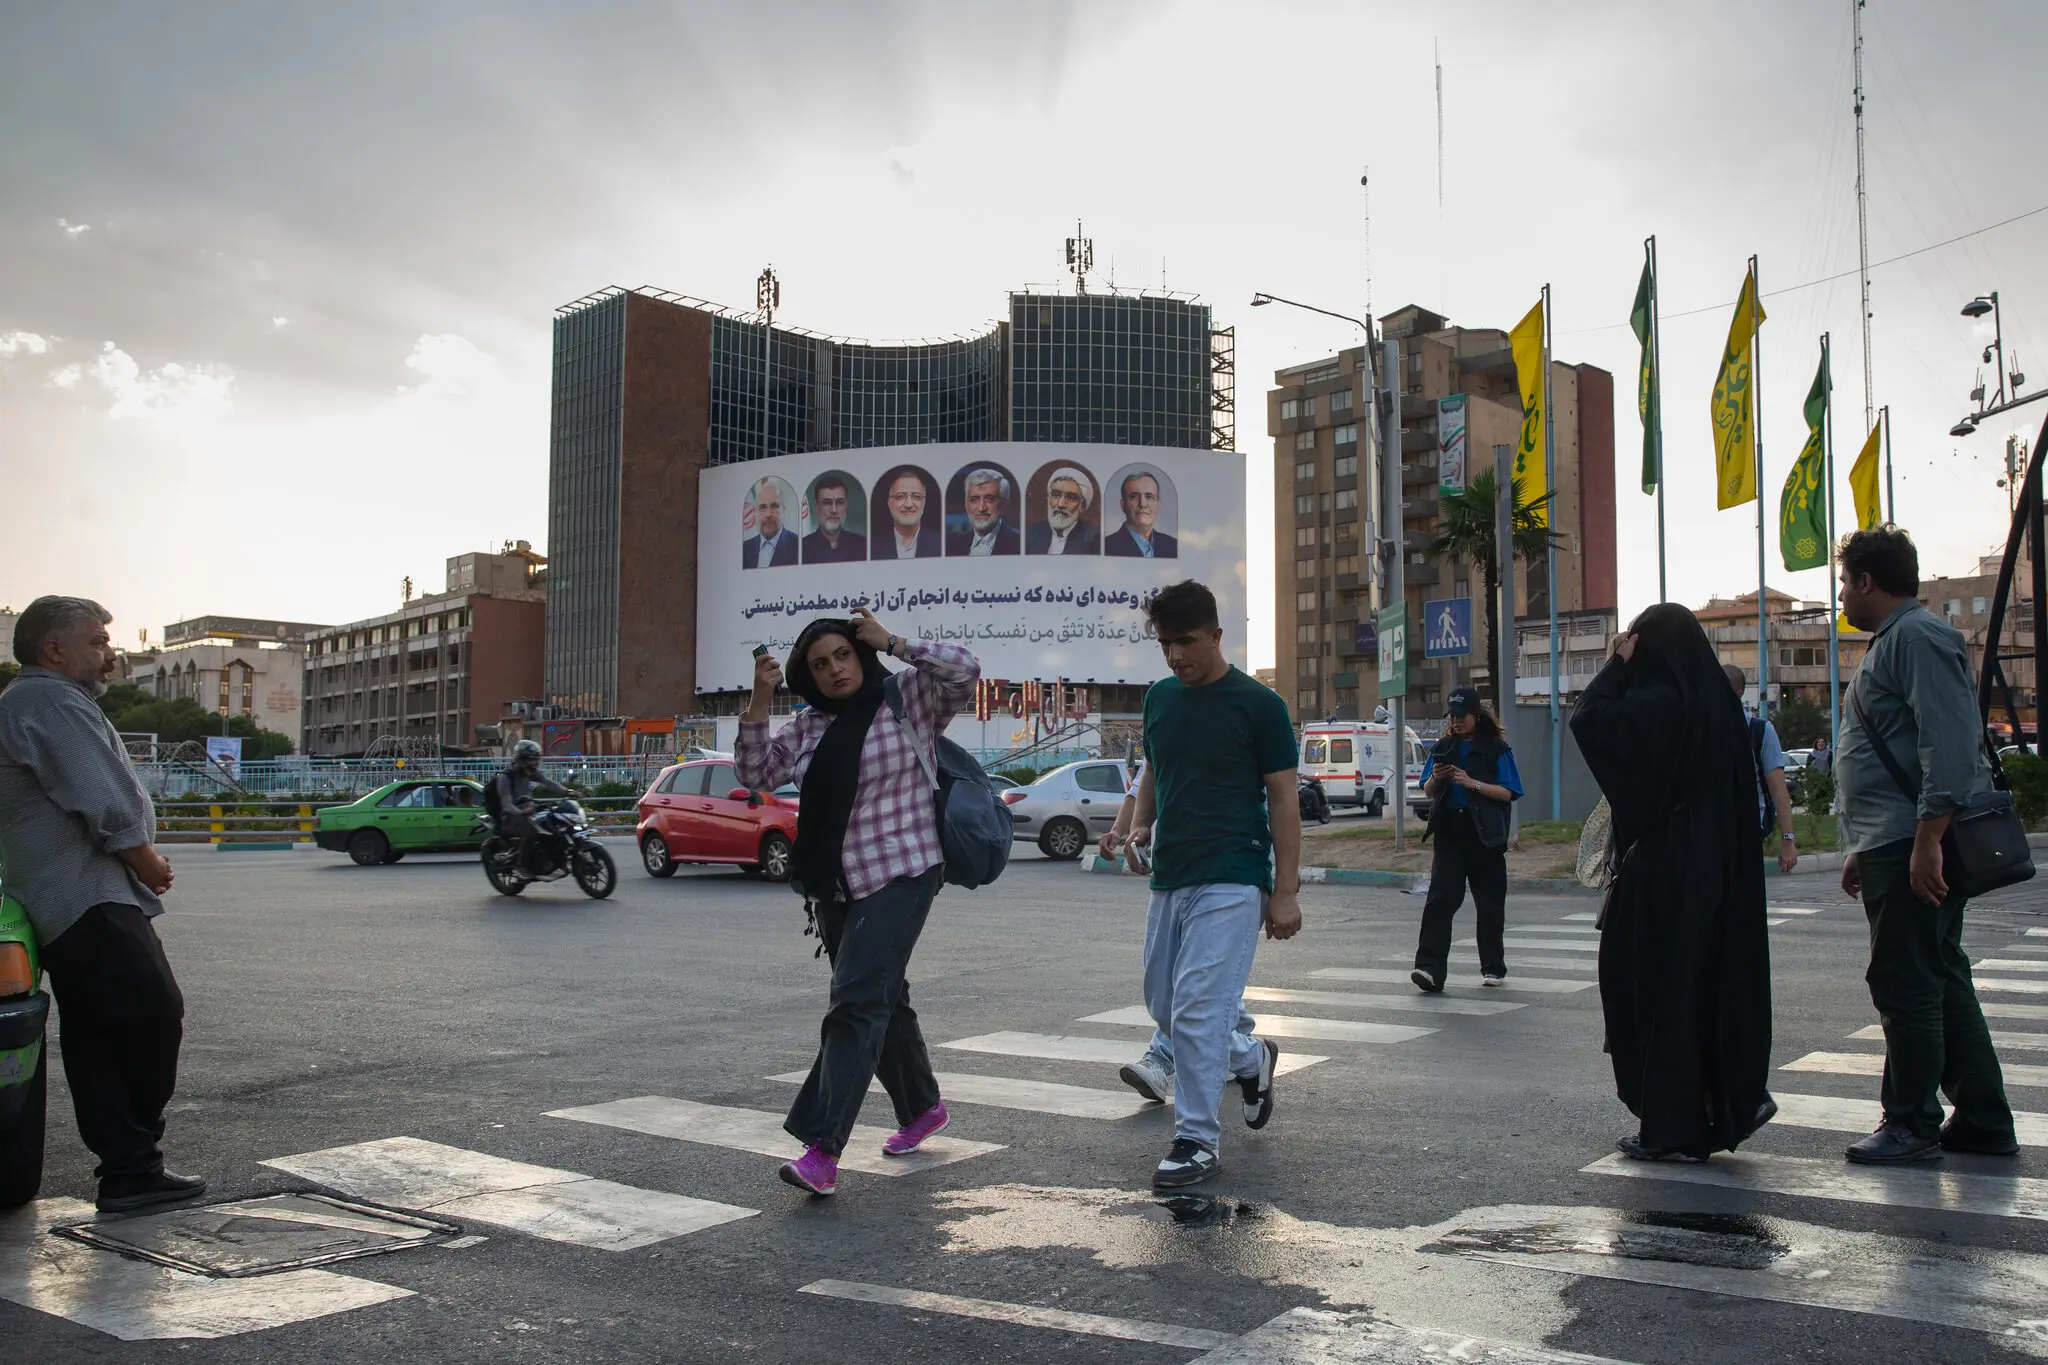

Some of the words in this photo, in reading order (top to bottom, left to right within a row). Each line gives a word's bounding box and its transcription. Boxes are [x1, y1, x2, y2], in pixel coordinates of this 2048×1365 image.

[786, 593, 838, 616] مطمئن
[840, 591, 871, 609] خود
[871, 590, 885, 612] از
[887, 587, 906, 612] آن
[907, 587, 950, 611] انجام
[952, 588, 969, 606] به
[970, 586, 1021, 608] نسبت
[1023, 585, 1043, 603] که
[1045, 586, 1074, 603] نده
[1076, 586, 1095, 608] ای
[1097, 590, 1139, 610] وعده
[1086, 622, 1096, 640] لا
